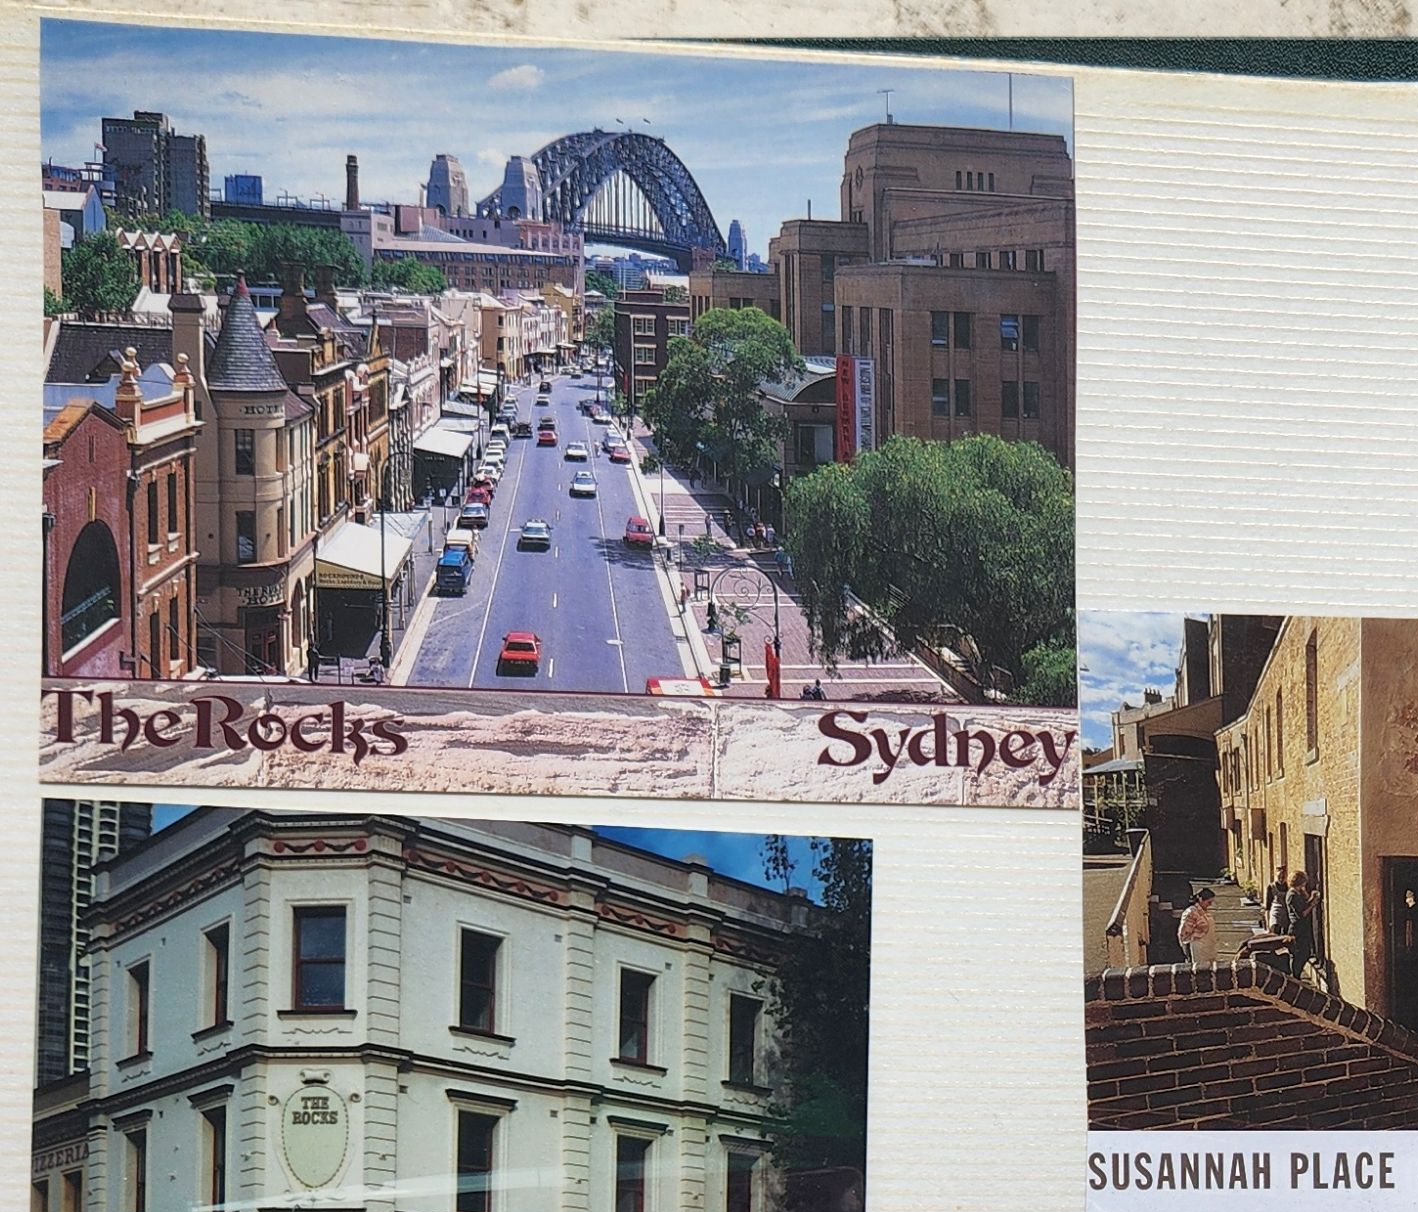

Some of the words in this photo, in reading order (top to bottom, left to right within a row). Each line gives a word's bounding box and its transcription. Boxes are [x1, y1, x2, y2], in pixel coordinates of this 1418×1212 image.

[817, 711, 1077, 785] Sydney
[301, 1096, 329, 1109] THE
[292, 1111, 338, 1125] ROCKS
[32, 1143, 89, 1173] IZZERIA
[1089, 1153, 1270, 1190] SUSANNAH
[1291, 1152, 1394, 1189] PLACE
